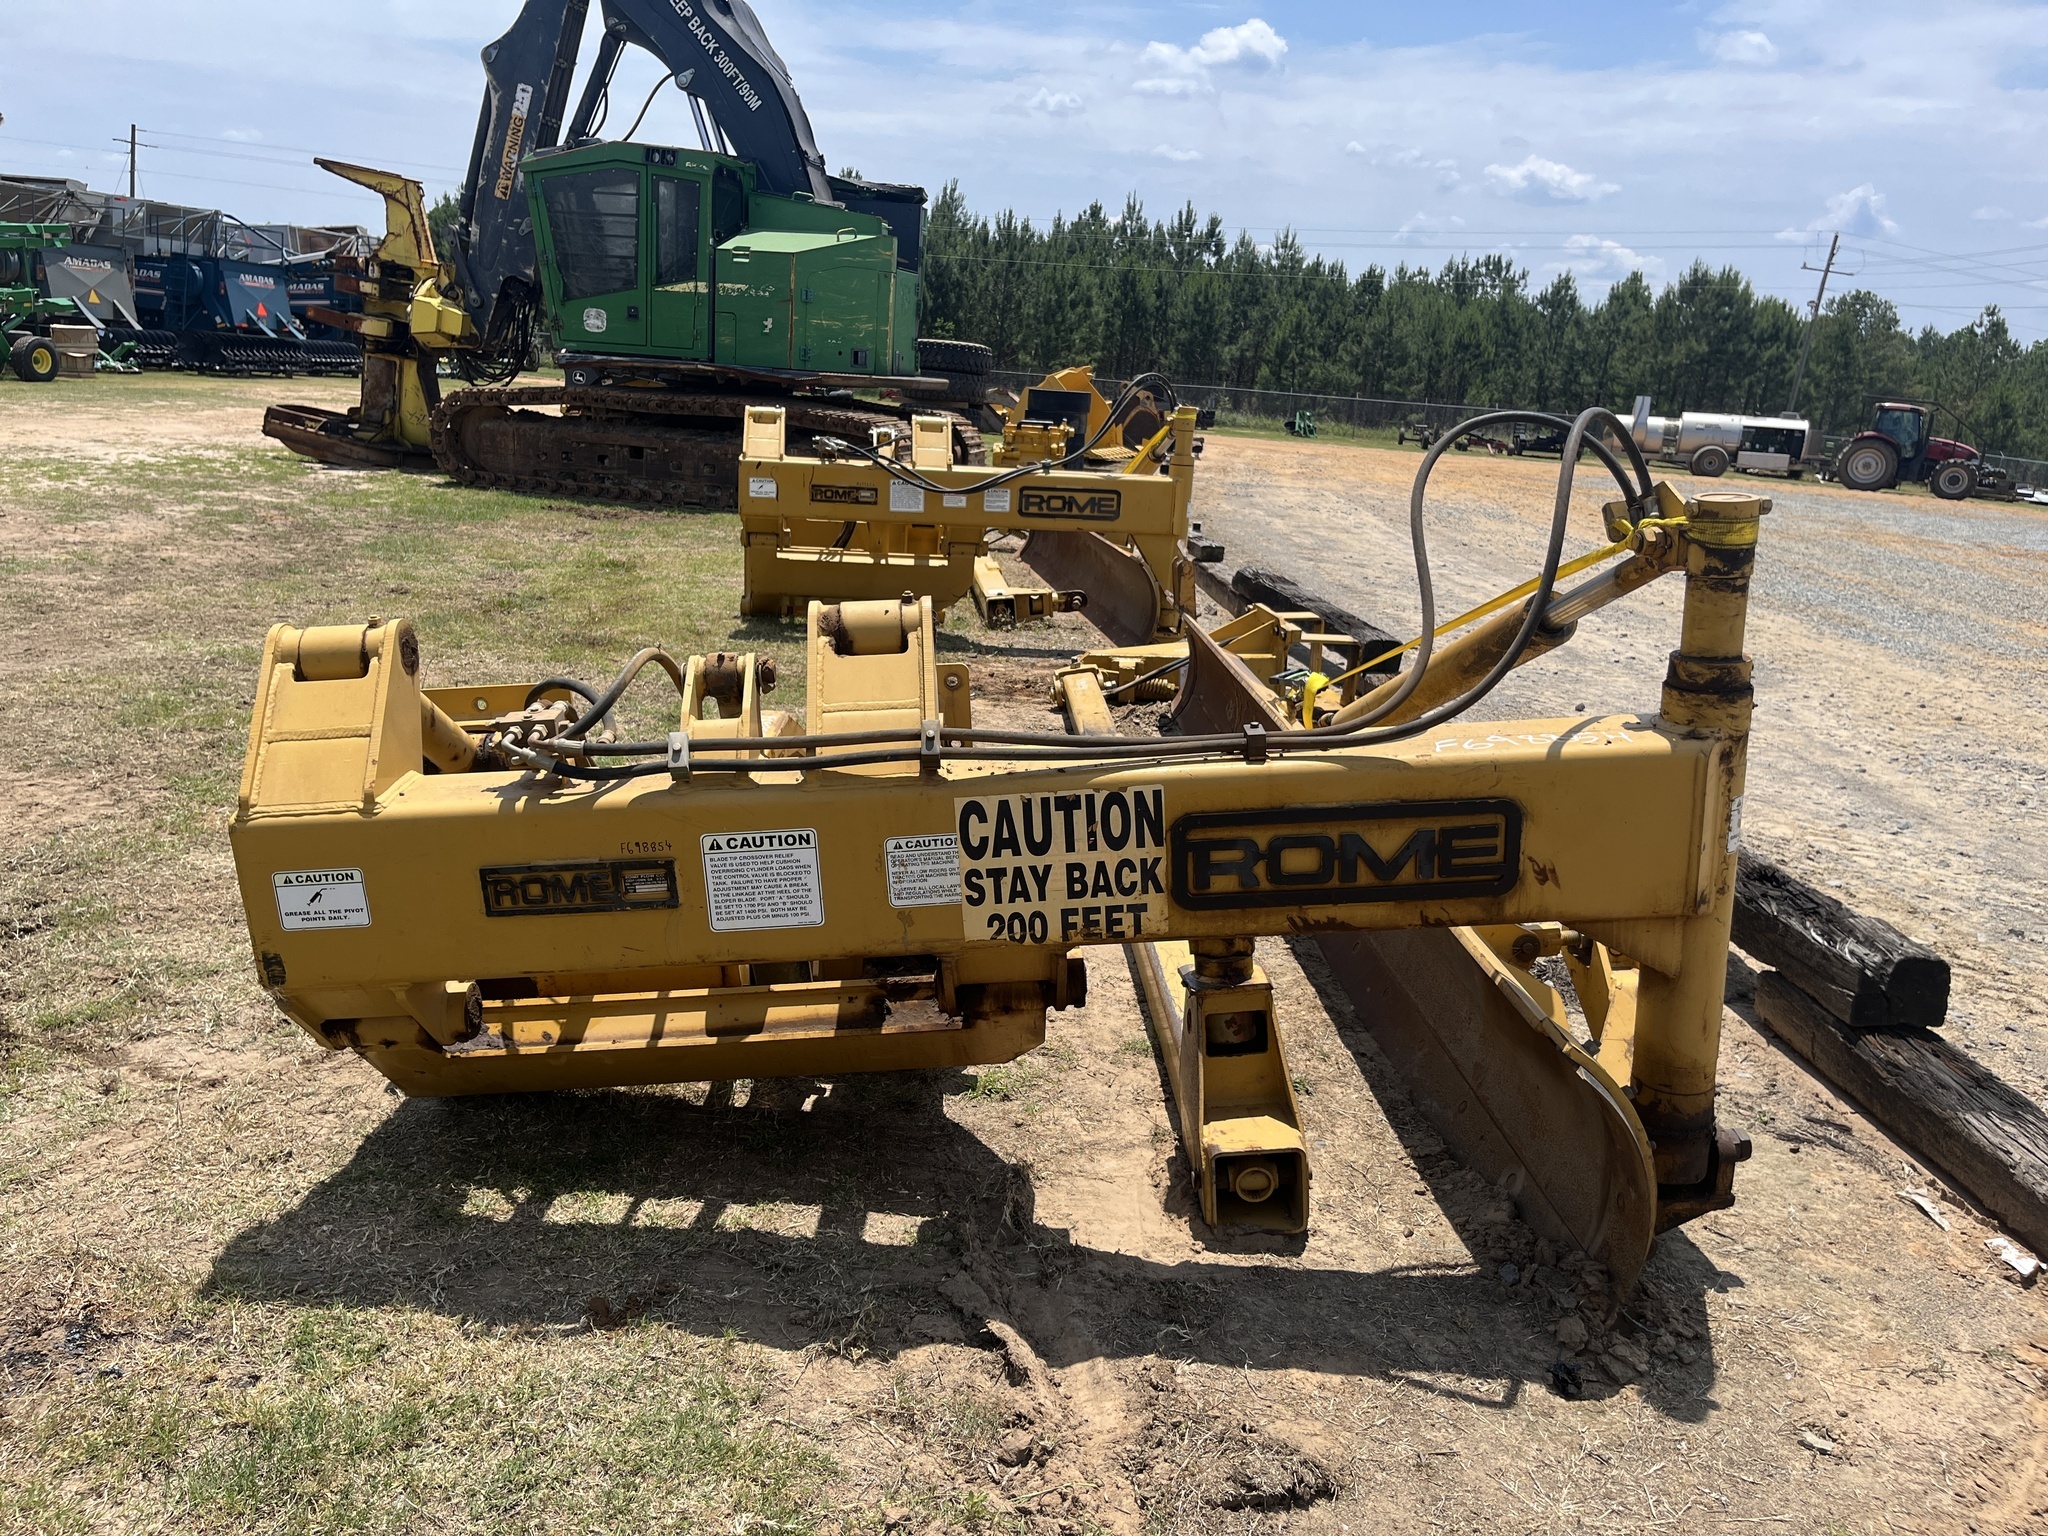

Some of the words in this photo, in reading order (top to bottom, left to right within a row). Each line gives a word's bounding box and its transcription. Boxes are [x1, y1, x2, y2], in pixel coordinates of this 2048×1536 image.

[687, 16, 719, 55] BACK
[713, 50, 762, 111] 300FT/90M
[501, 117, 524, 181] WARNING
[63, 256, 111, 269] AMADAS
[239, 273, 274, 285] AMADAS
[812, 488, 857, 500] ROME
[1023, 495, 1115, 515] ROME
[959, 789, 1164, 861] CAUTION
[620, 840, 673, 854] F698854
[726, 833, 811, 850] CAUTION
[1187, 824, 1501, 890] ROME
[295, 872, 354, 883] CAUTION
[487, 872, 611, 906] ROME
[964, 864, 1053, 907] STAY
[1065, 857, 1165, 900] BACK
[987, 910, 1048, 944] 200
[1060, 903, 1148, 942] FEET
